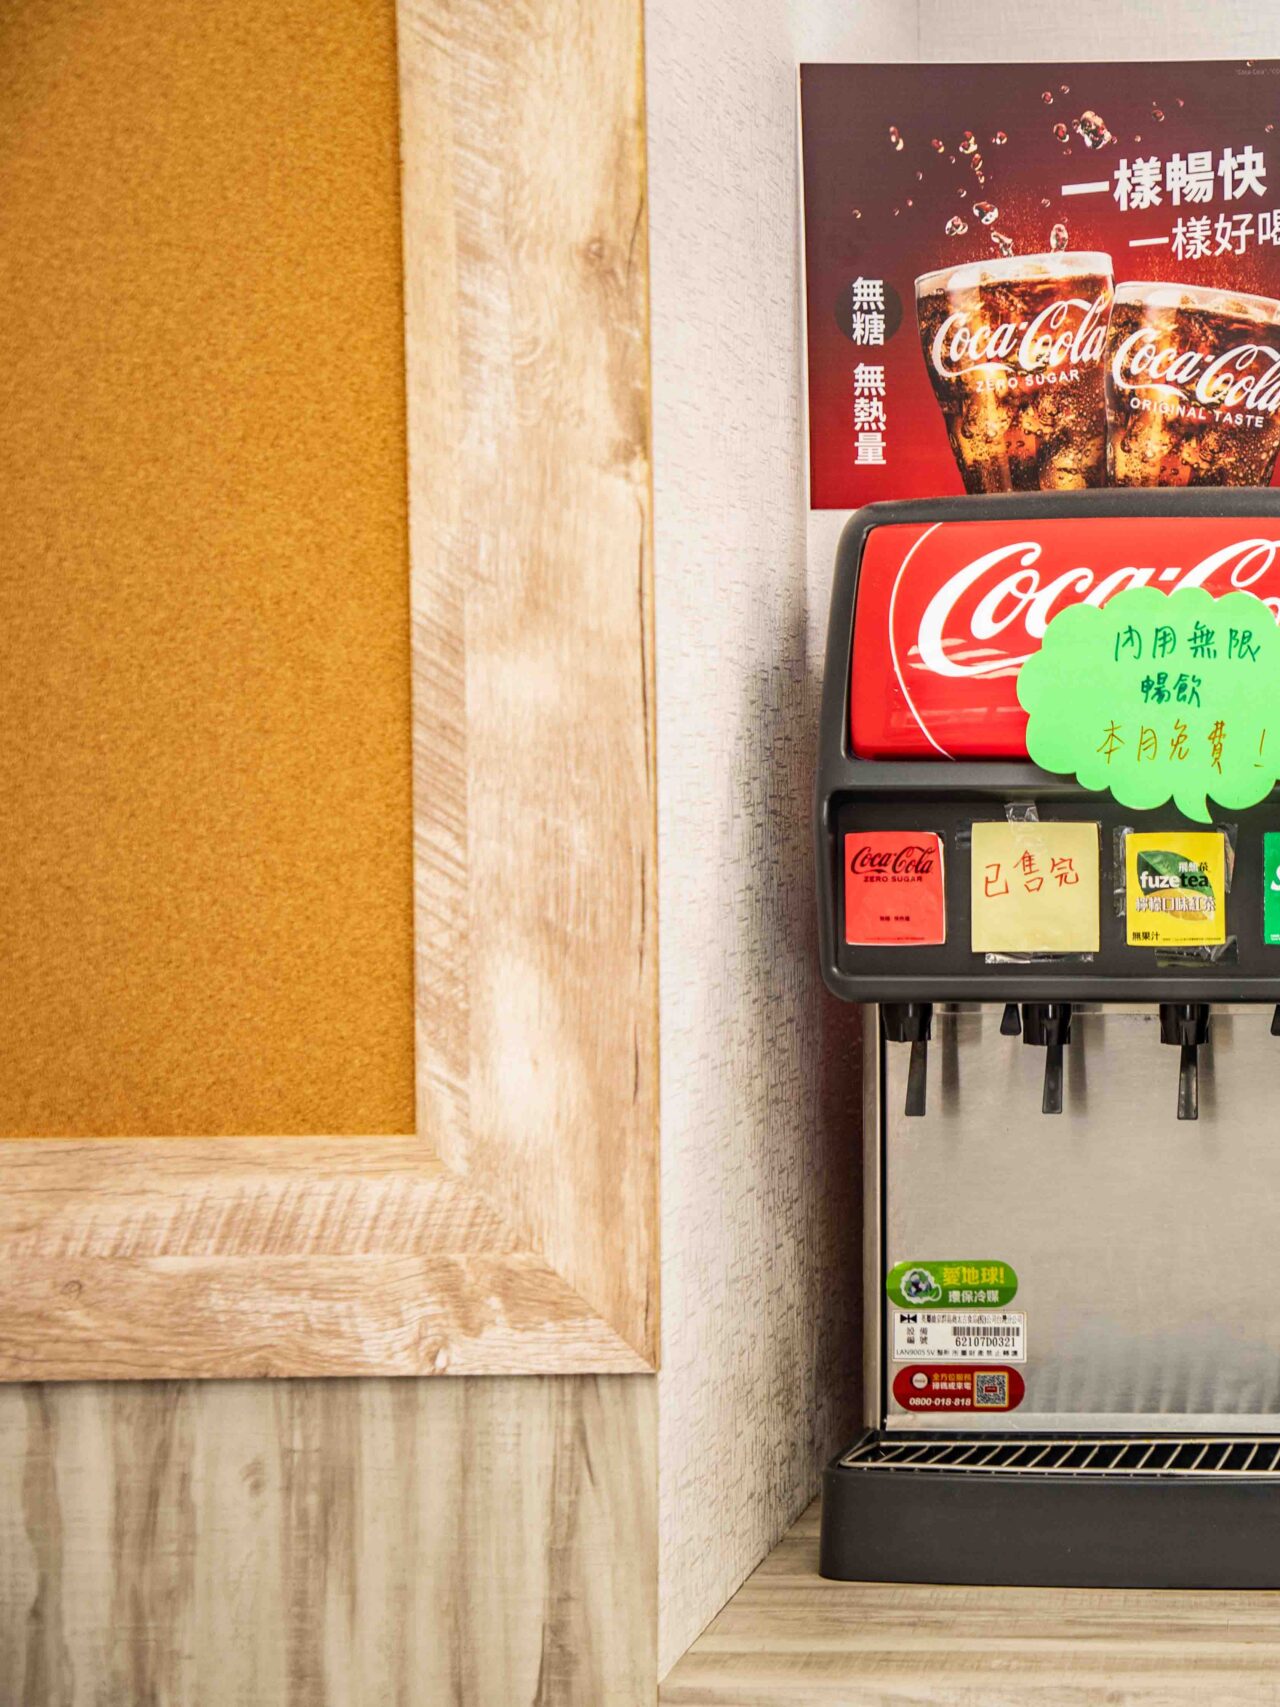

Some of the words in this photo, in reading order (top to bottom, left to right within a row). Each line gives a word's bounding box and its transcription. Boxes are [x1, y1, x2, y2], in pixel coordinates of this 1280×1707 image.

[1061, 144, 1267, 212] 一樣暢快
[852, 277, 885, 346] 無糖
[932, 295, 1112, 377] Coca-Cola
[975, 377, 1018, 393] ZERO
[1025, 369, 1080, 387] SUGAR
[853, 363, 886, 465] 無熱量
[1130, 397, 1206, 420] ORIGINAL
[1214, 411, 1264, 428] TASTE
[1141, 671, 1202, 708] 暢飲
[851, 846, 936, 875] Coca-Cola
[984, 850, 1080, 898] 已售完
[943, 1267, 1005, 1286] 愛地球!
[948, 1290, 1000, 1303] 環保冷媒
[955, 1337, 1015, 1347] 62107D0321
[909, 1397, 971, 1406] 0800-018-818
